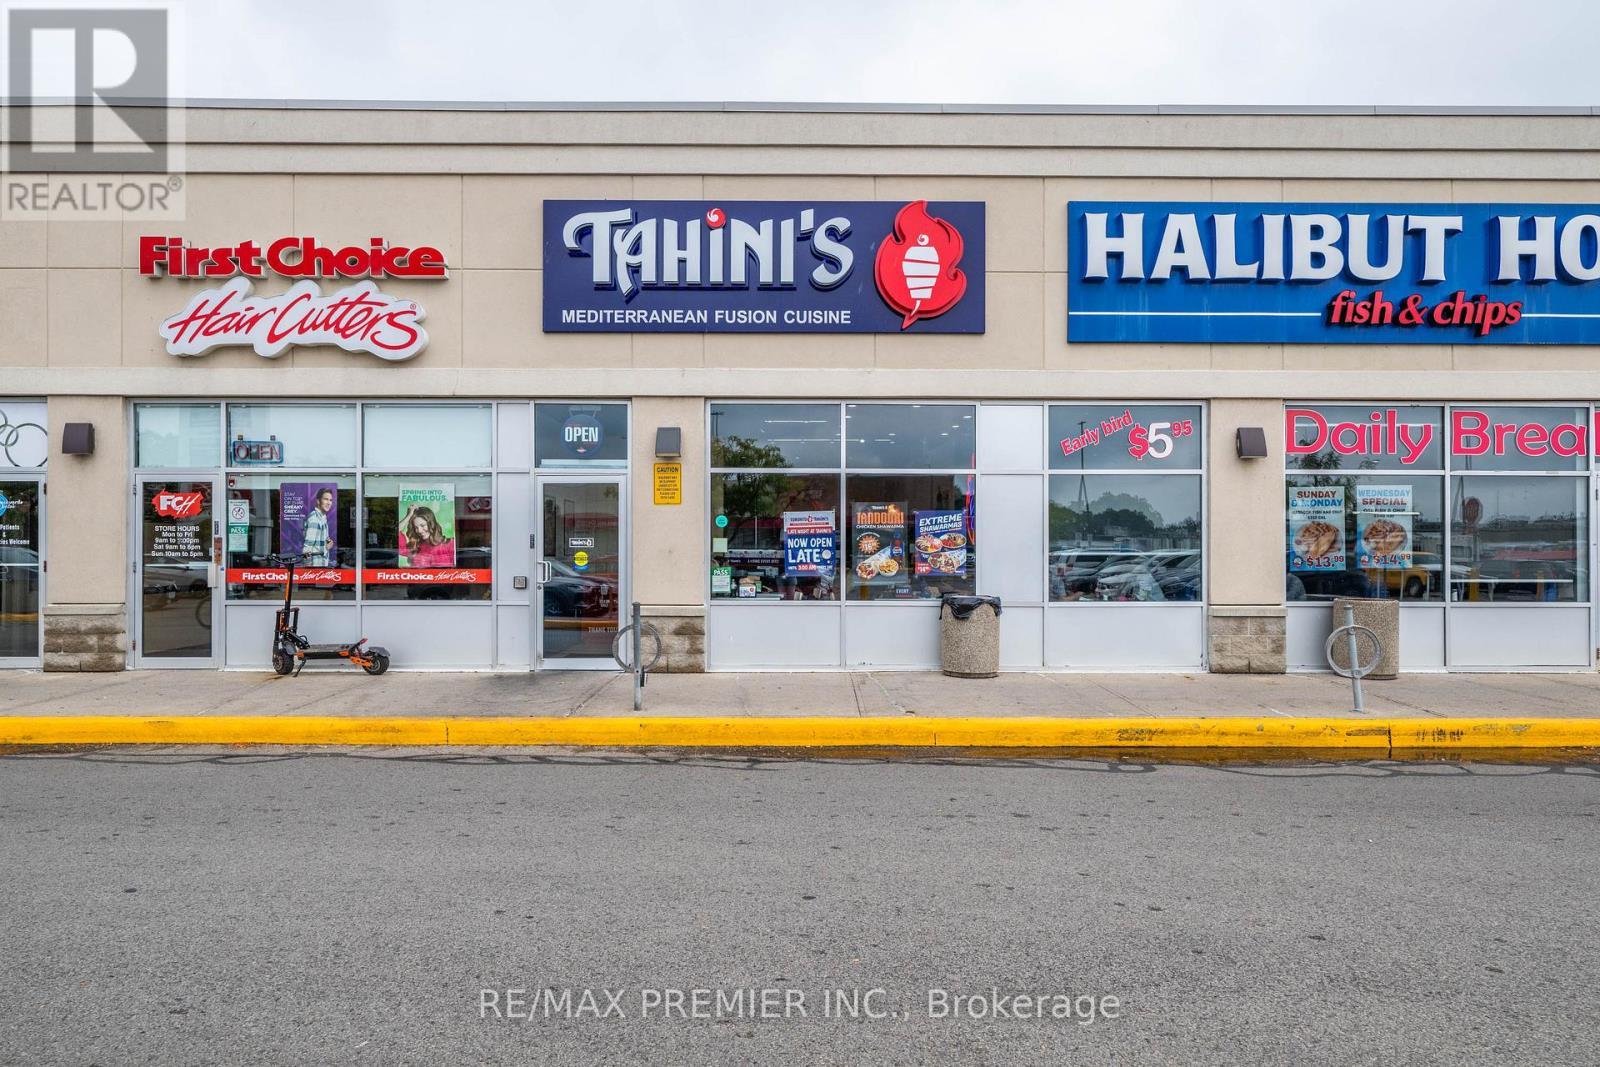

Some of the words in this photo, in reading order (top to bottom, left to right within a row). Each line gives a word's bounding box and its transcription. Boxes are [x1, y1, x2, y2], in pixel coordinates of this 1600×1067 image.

[1084, 211, 1463, 283] HALIBUT
[1494, 214, 1600, 283] HO
[139, 236, 262, 277] First
[266, 236, 446, 277] Choice
[167, 290, 278, 345] Hair
[562, 309, 707, 324] MEDITERRANEAN
[714, 310, 777, 324] FUSION
[783, 310, 851, 325] CUISINE
[1329, 289, 1393, 327] fish
[1398, 293, 1430, 326] &
[1433, 289, 1523, 337] chips
[564, 426, 599, 442] OPEN
[1060, 426, 1100, 456] Early
[1101, 408, 1135, 437] bird
[1285, 408, 1433, 464] Daily
[1451, 410, 1600, 456] Brea
[235, 444, 281, 461] OPEN
[1296, 490, 1337, 498] SUNDAY
[1358, 489, 1411, 497] WEDNESDAY
[1300, 499, 1343, 507] ONDAY
[1362, 497, 1407, 505] SPECIAL
[919, 513, 962, 527] EXTREME
[919, 521, 962, 533] SHAWARMAS
[788, 537, 808, 548] NOW
[810, 537, 832, 547] OPEN
[788, 549, 820, 563] LATE
[242, 572, 266, 580] First
[265, 572, 299, 580] Choie
[377, 572, 400, 580] First
[400, 572, 434, 580] Choice
